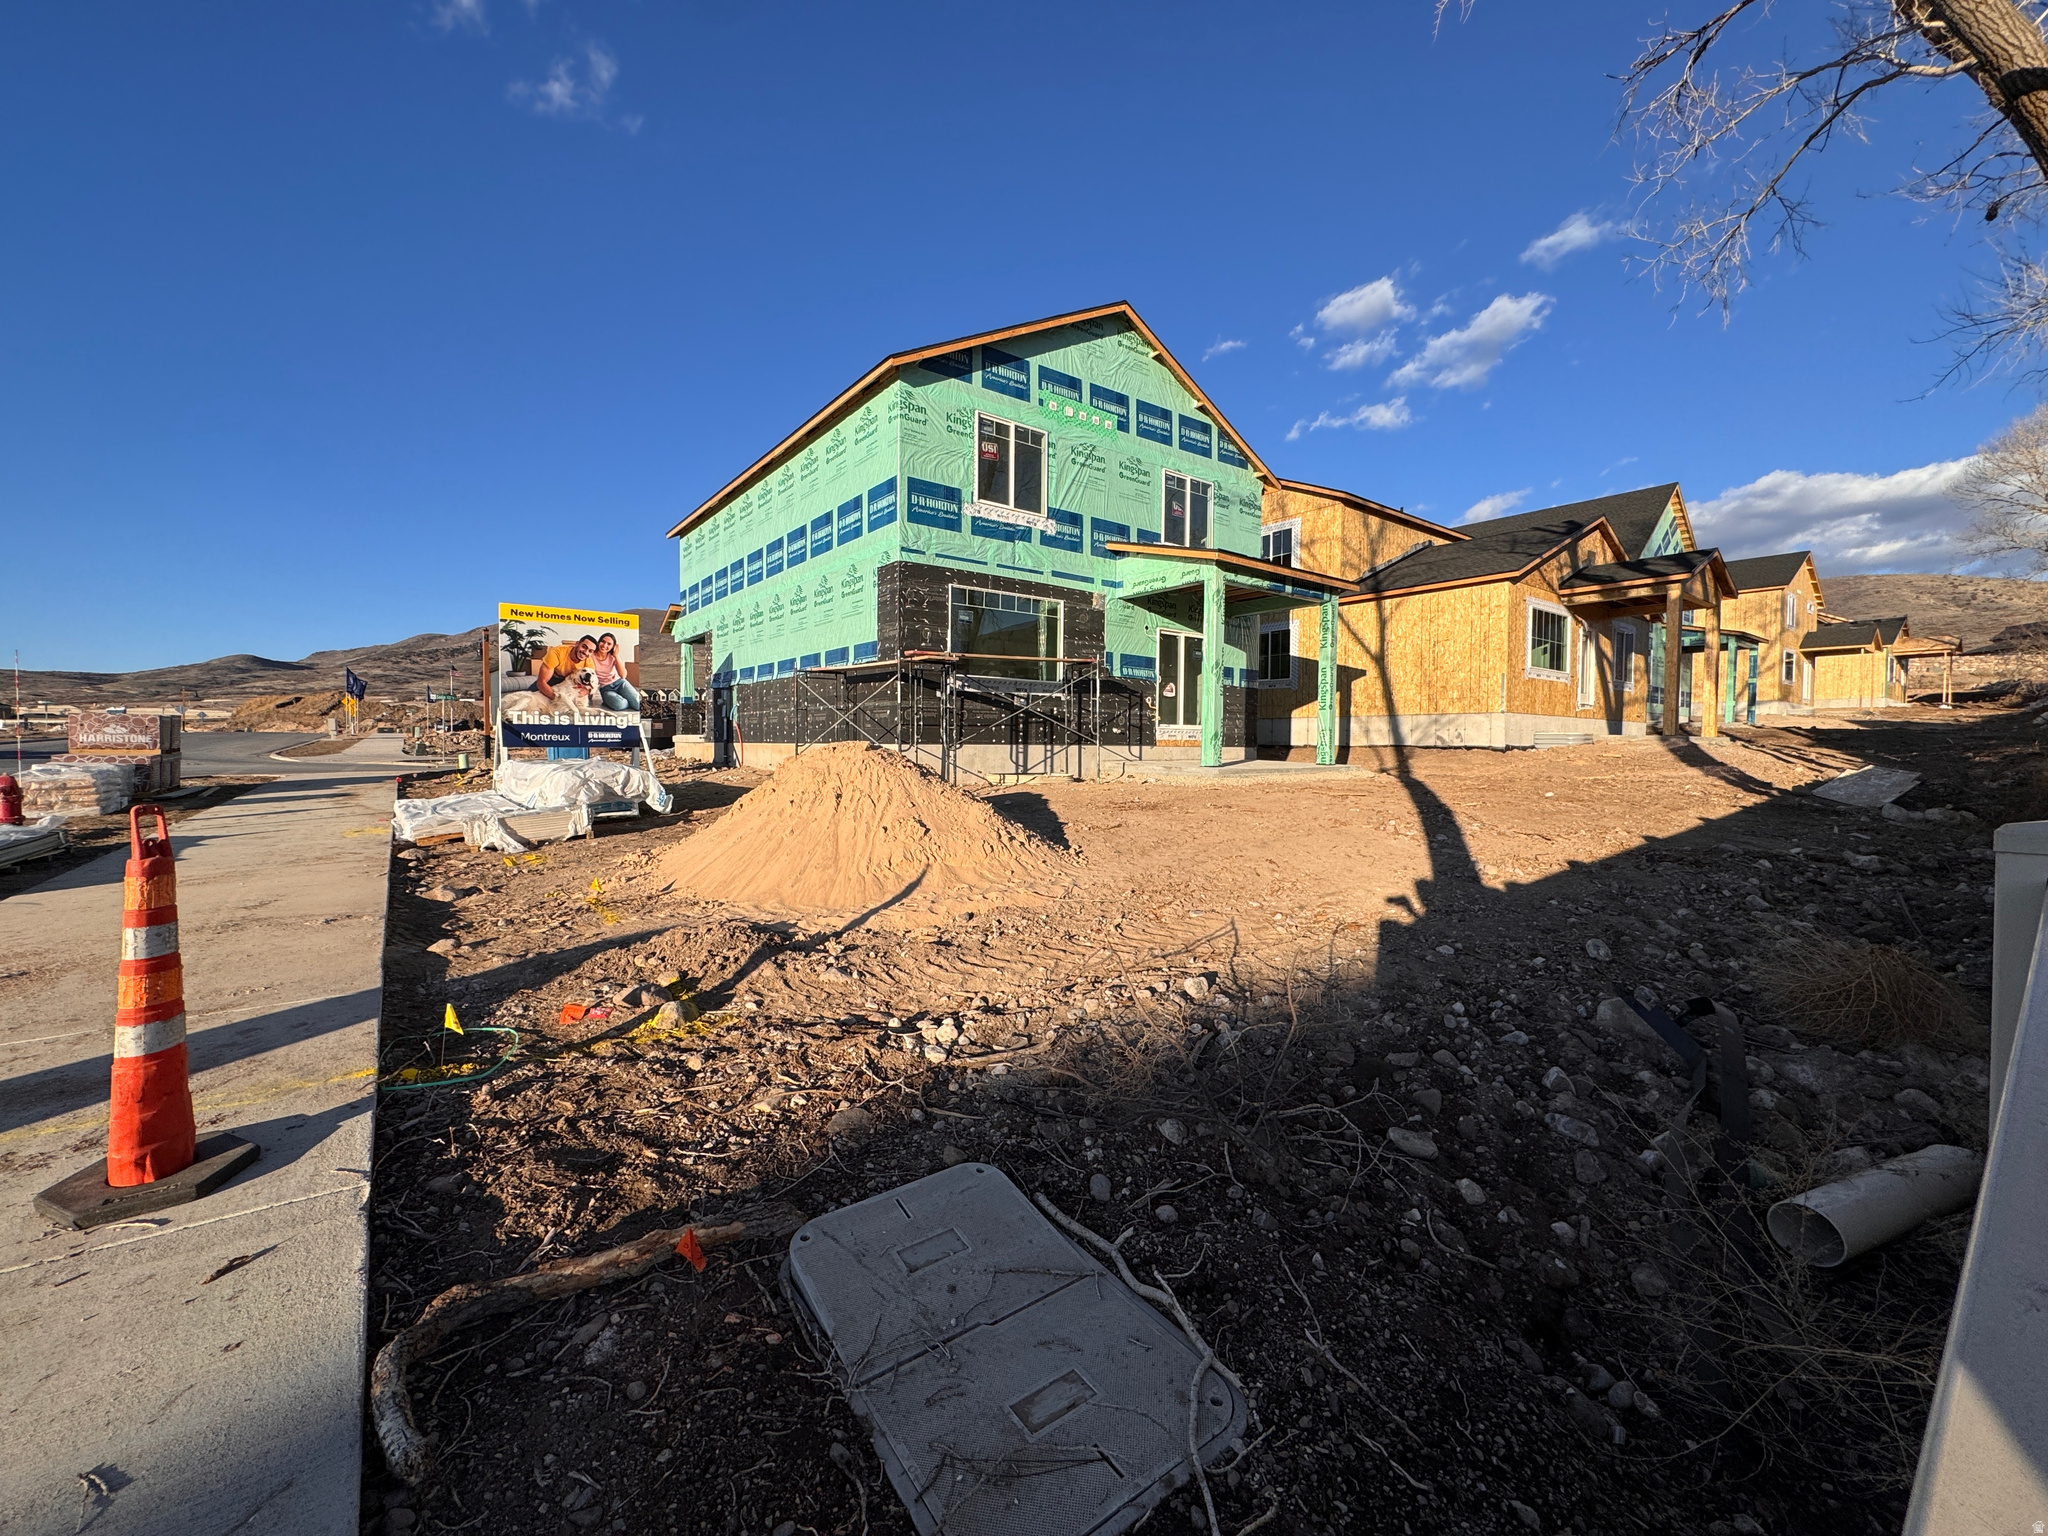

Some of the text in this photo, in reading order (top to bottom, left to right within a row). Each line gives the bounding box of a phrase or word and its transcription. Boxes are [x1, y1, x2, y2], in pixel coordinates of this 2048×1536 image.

[888, 399, 927, 416] Kingspan
[854, 414, 878, 436] Kingspan
[888, 413, 929, 427] GreenGuard
[946, 411, 972, 430] Kings
[854, 424, 879, 446] GreenGuard
[946, 424, 974, 440] GreenG
[982, 442, 997, 454] USI
[1070, 445, 1106, 465] Kingspan
[1071, 457, 1107, 474] GreenGuard
[1119, 460, 1151, 479] Kingspan
[1119, 471, 1151, 487] GreenGuard
[911, 505, 959, 521] America's Builder
[841, 574, 864, 589] Kingspan
[1180, 568, 1200, 580] Guard
[813, 586, 834, 600] Kingspan
[841, 585, 864, 599] GreenGuard
[813, 596, 834, 608] GreenGuard
[510, 608, 630, 627] New Homes Now Selling
[1320, 604, 1330, 649] Kingspan
[1318, 666, 1329, 711] Kingspan
[509, 710, 634, 729] This is Living!
[79, 733, 153, 743] HARRISTONE
[520, 731, 571, 742] Montreux
